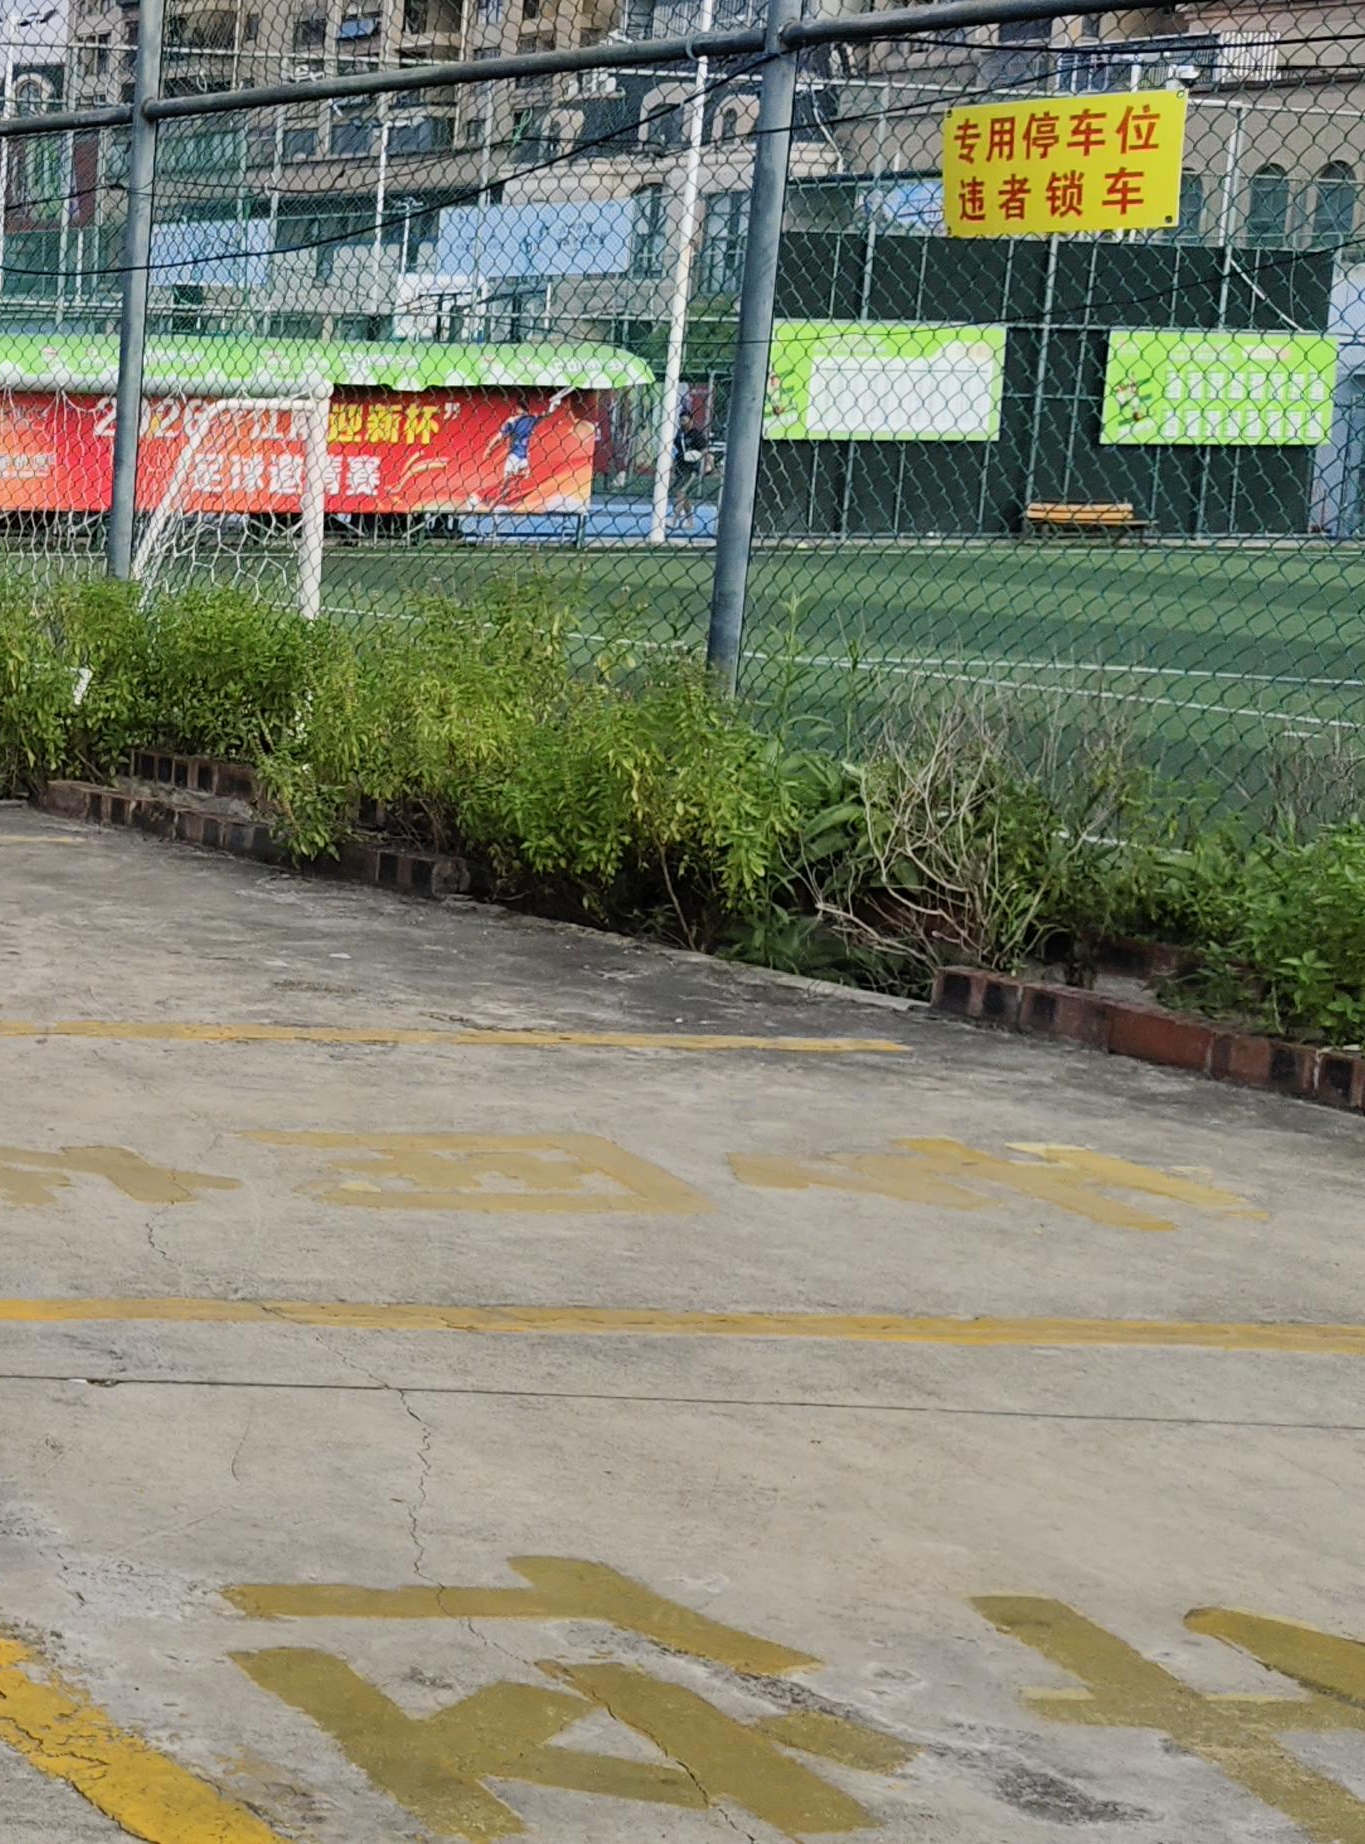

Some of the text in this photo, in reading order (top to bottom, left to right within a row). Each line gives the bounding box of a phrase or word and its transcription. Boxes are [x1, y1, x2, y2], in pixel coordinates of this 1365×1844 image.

[954, 104, 1162, 164] 专用停车位
[958, 167, 1145, 221] 违者锁车
